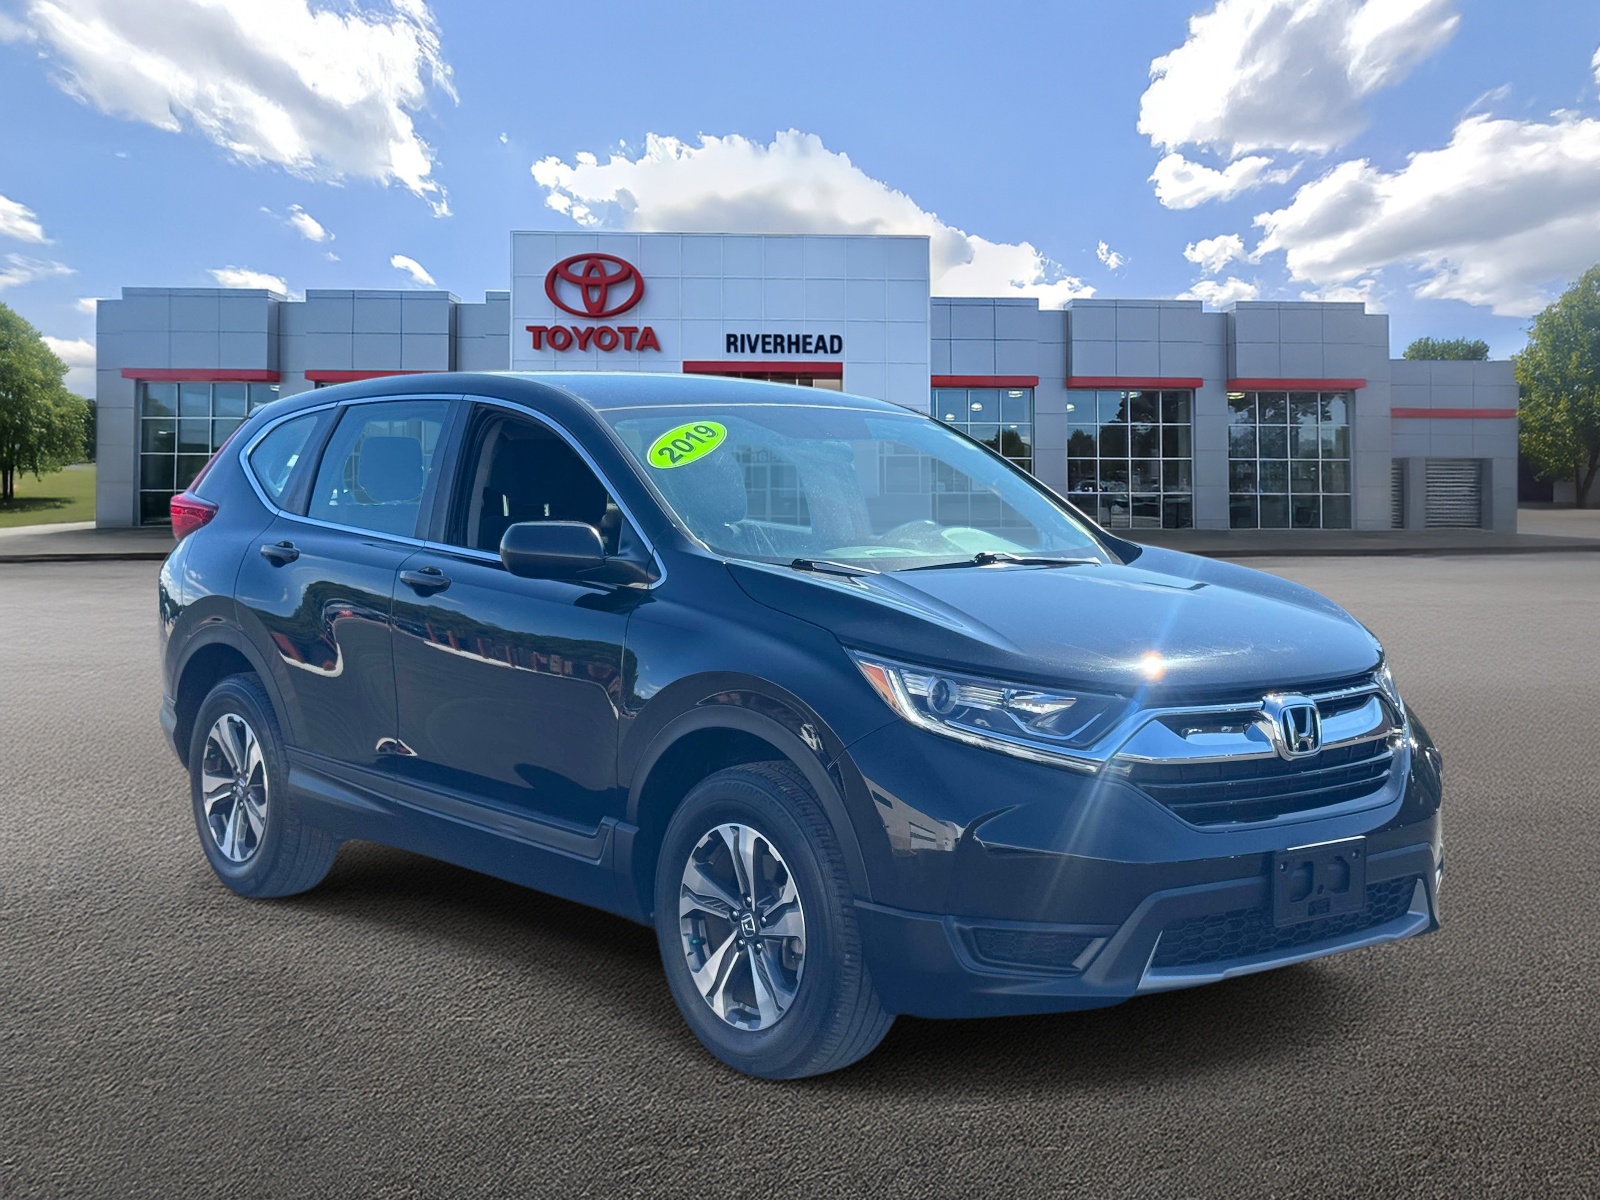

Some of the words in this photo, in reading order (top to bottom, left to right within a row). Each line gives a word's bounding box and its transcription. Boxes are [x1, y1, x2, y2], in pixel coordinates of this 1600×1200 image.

[526, 325, 660, 351] TOYOTA
[726, 333, 843, 354] RIVERHEAD
[658, 425, 717, 464] 2019
